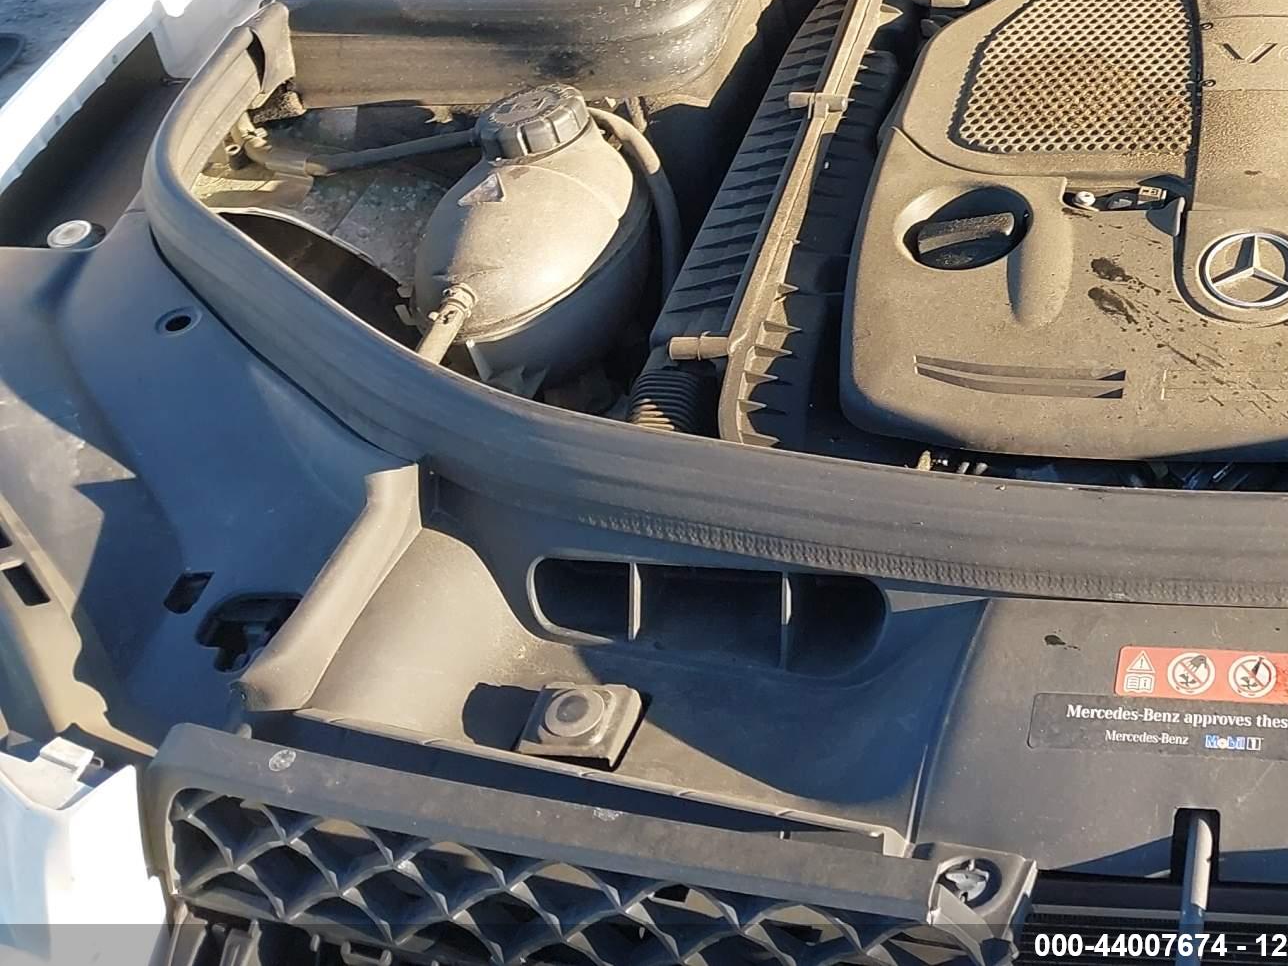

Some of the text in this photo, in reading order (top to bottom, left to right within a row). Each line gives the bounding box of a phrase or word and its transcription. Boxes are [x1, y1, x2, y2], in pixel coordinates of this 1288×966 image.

[1066, 704, 1180, 723] Mercedes-Benz
[1183, 713, 1252, 727] approves
[1104, 729, 1261, 750] Mercedes-Benz Mobil 1
